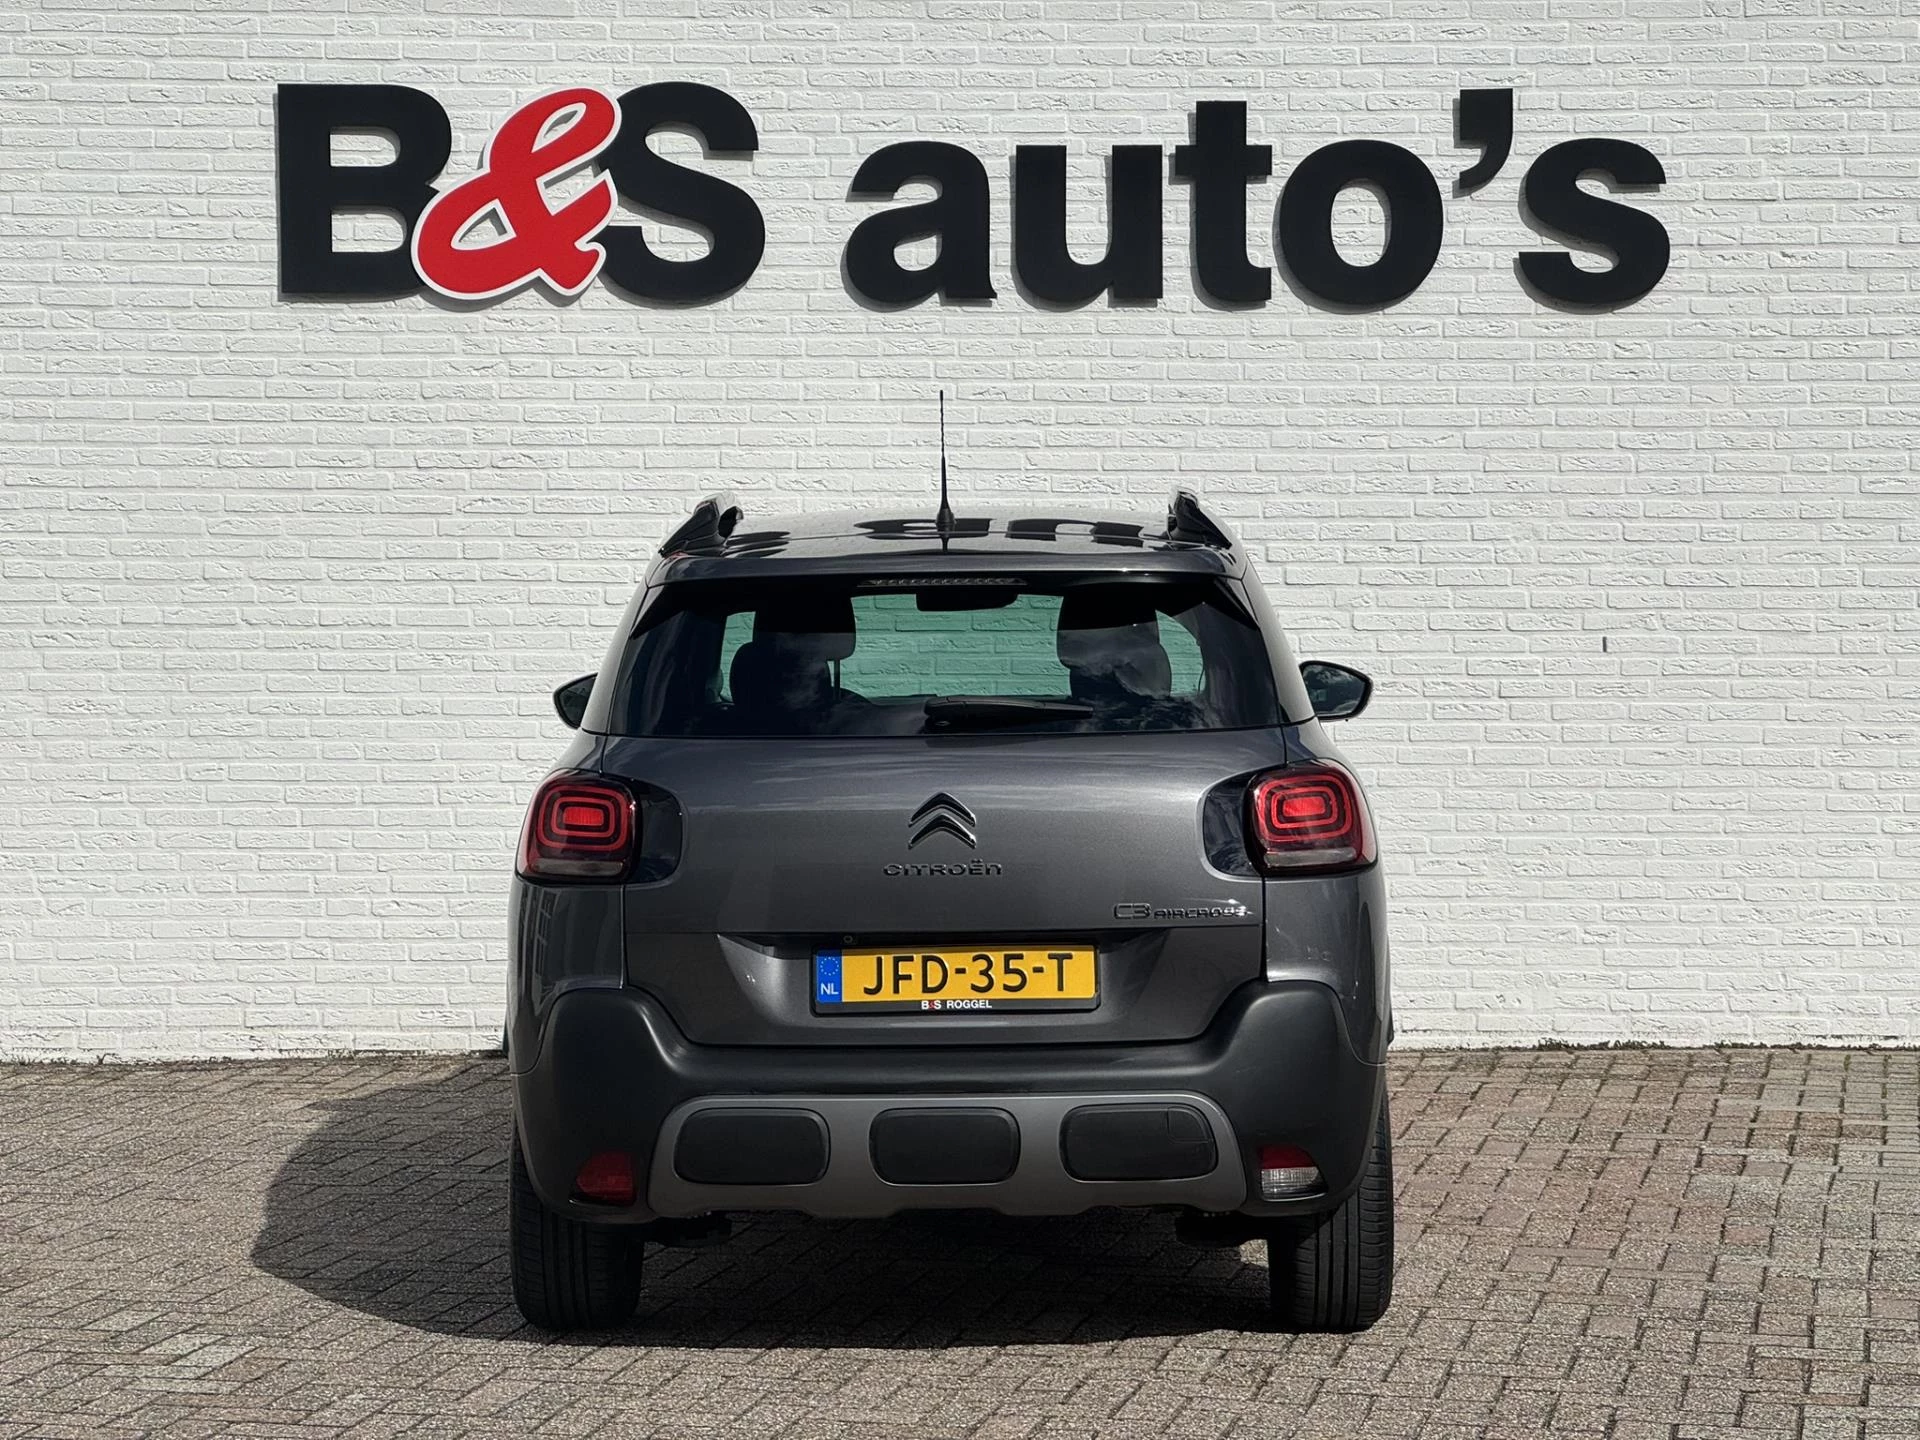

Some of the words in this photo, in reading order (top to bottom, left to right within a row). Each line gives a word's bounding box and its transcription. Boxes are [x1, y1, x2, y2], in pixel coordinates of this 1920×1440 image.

[276, 82, 767, 309] B&S
[844, 88, 1671, 310] auto's
[1113, 903, 1151, 920] C3
[1153, 906, 1249, 919] AIRCROSS
[863, 953, 1074, 995] JFD-35-T
[820, 983, 839, 995] NL
[921, 1000, 942, 1010] B&S
[946, 1000, 993, 1009] ROGGEL
